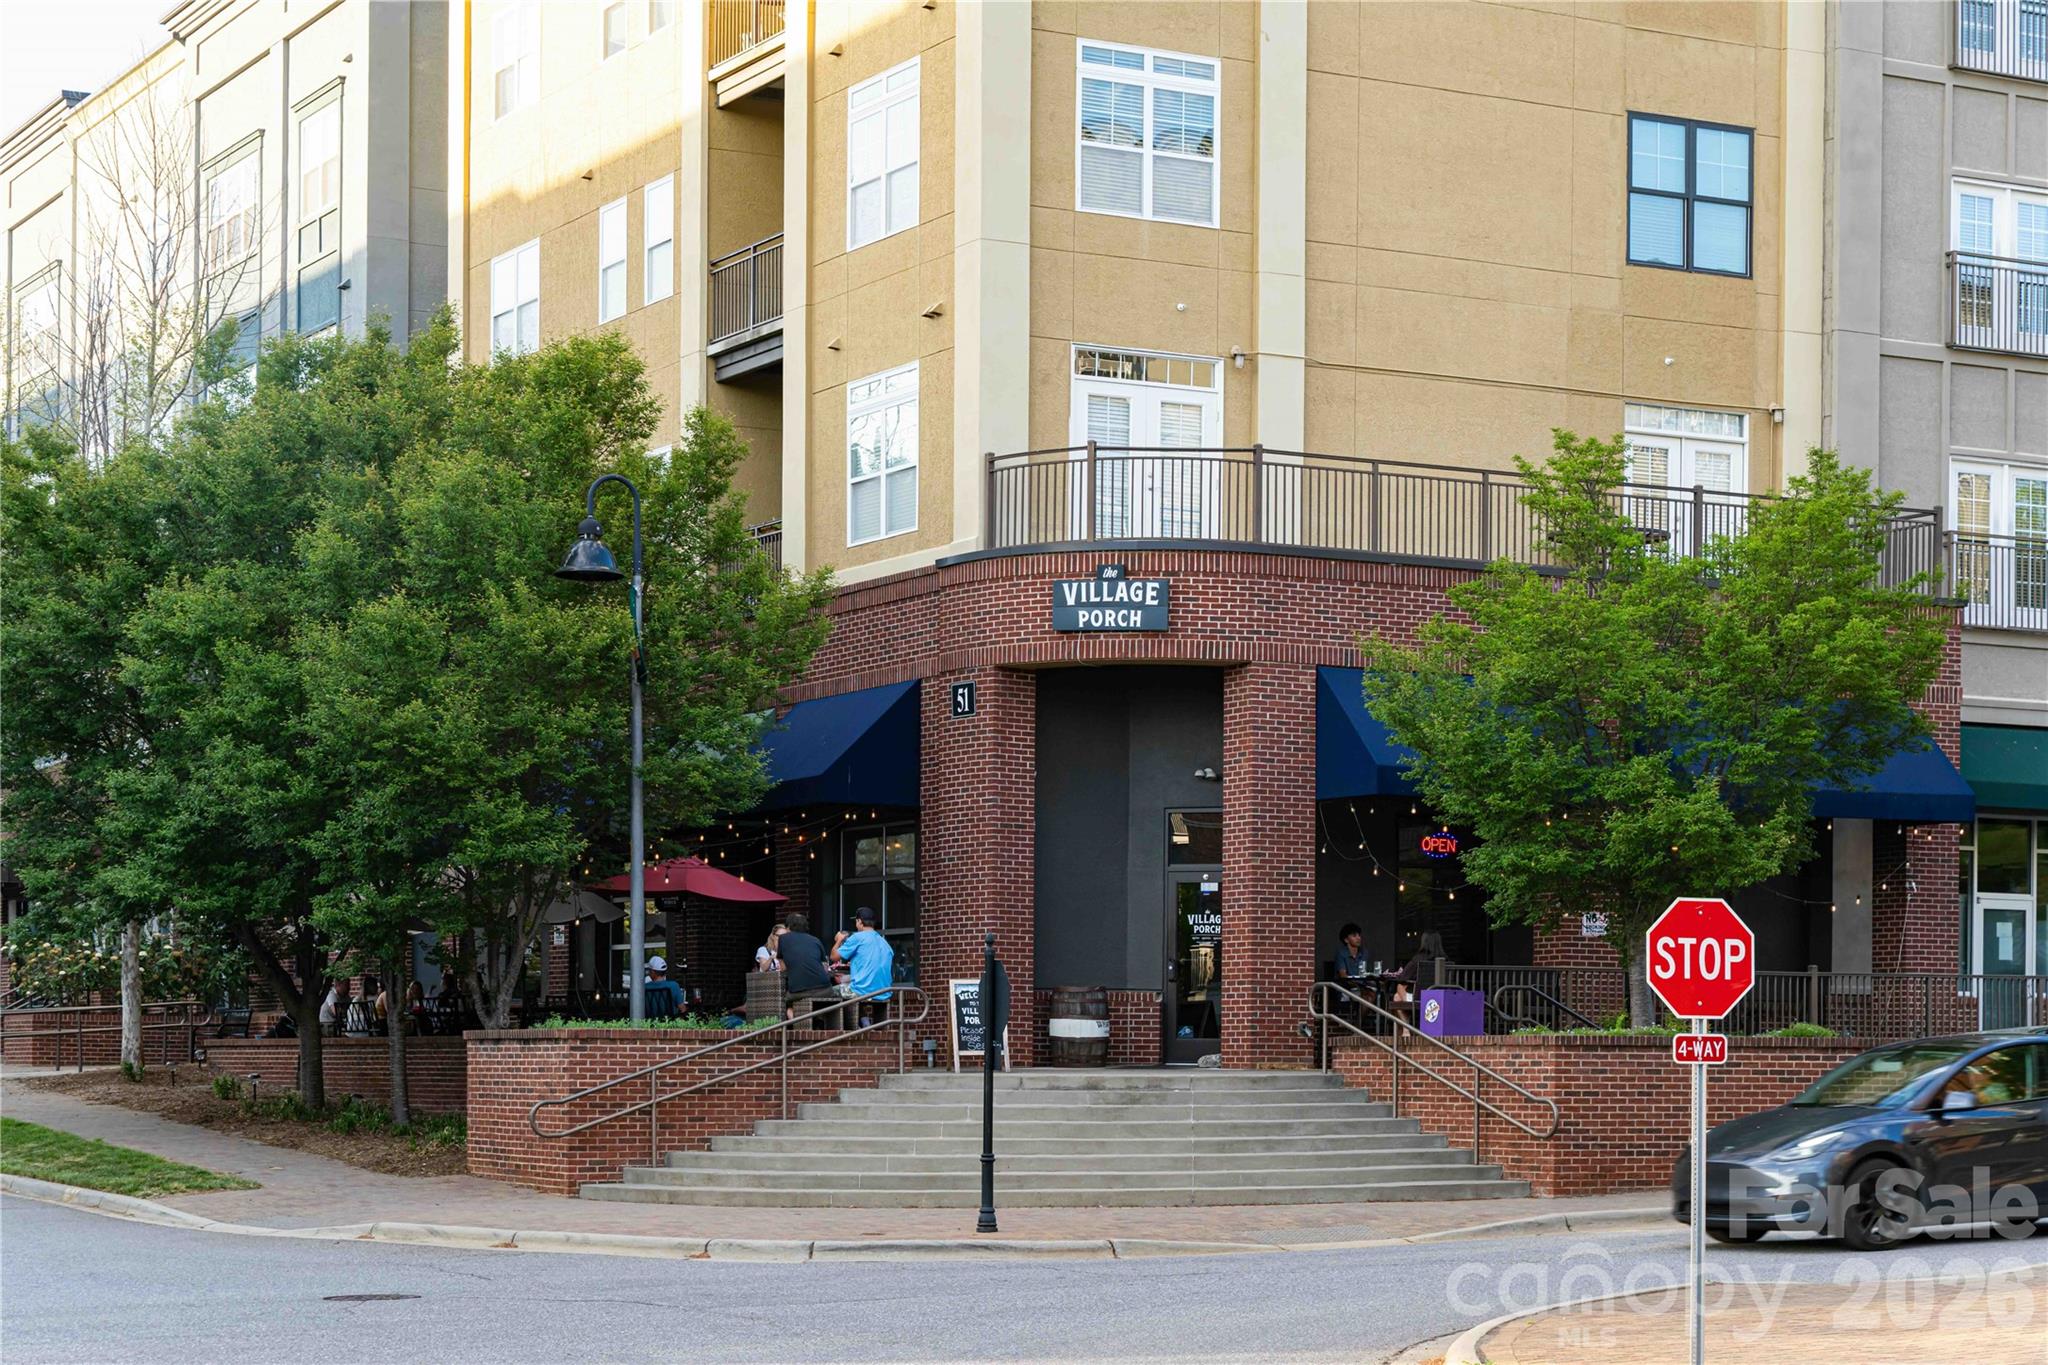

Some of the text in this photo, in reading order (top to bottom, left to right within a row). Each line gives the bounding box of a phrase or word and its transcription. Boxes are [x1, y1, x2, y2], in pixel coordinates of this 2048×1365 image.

[1102, 566, 1118, 579] the
[1062, 581, 1160, 606] VILLAGE
[1078, 609, 1142, 628] PORCH
[957, 687, 969, 712] 51
[1422, 837, 1456, 853] OPEN
[1187, 914, 1221, 925] VILLAG
[1193, 925, 1221, 934] PORCH
[1654, 936, 1746, 981] STOP
[958, 992, 978, 1000] WELC
[964, 1016, 980, 1024] POR
[1678, 1041, 1722, 1057] 4-WAY
